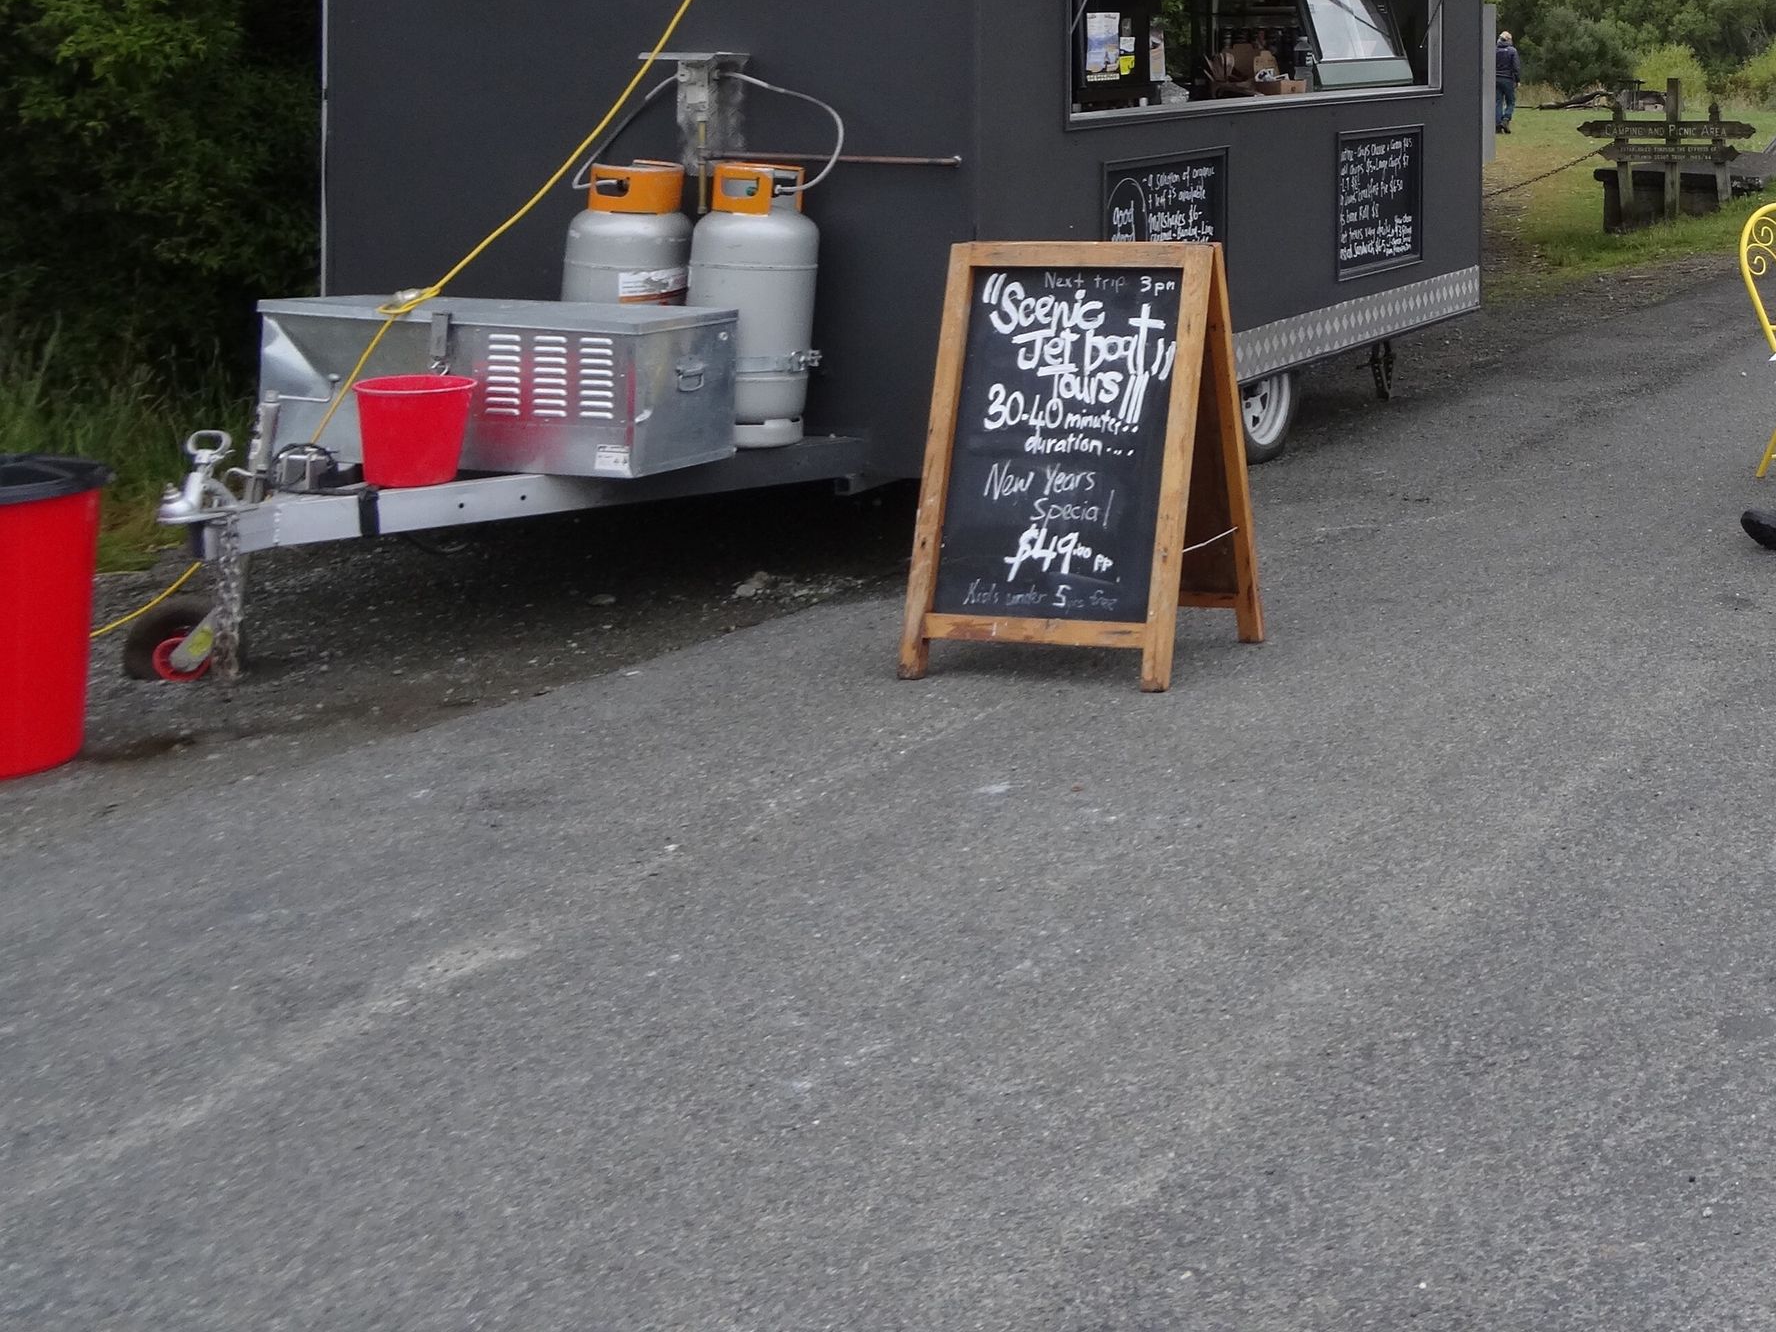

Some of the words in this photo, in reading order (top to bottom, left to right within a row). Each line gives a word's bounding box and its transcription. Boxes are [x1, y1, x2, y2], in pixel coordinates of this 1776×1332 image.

[1044, 271, 1085, 289] Next
[1094, 273, 1126, 293] trip
[1011, 327, 1081, 370] Jet
[984, 383, 1063, 431] 30-40
[983, 459, 1035, 500] New
[1043, 462, 1097, 496] Years
[1029, 489, 1116, 529] Special
[963, 578, 999, 606] Kids
